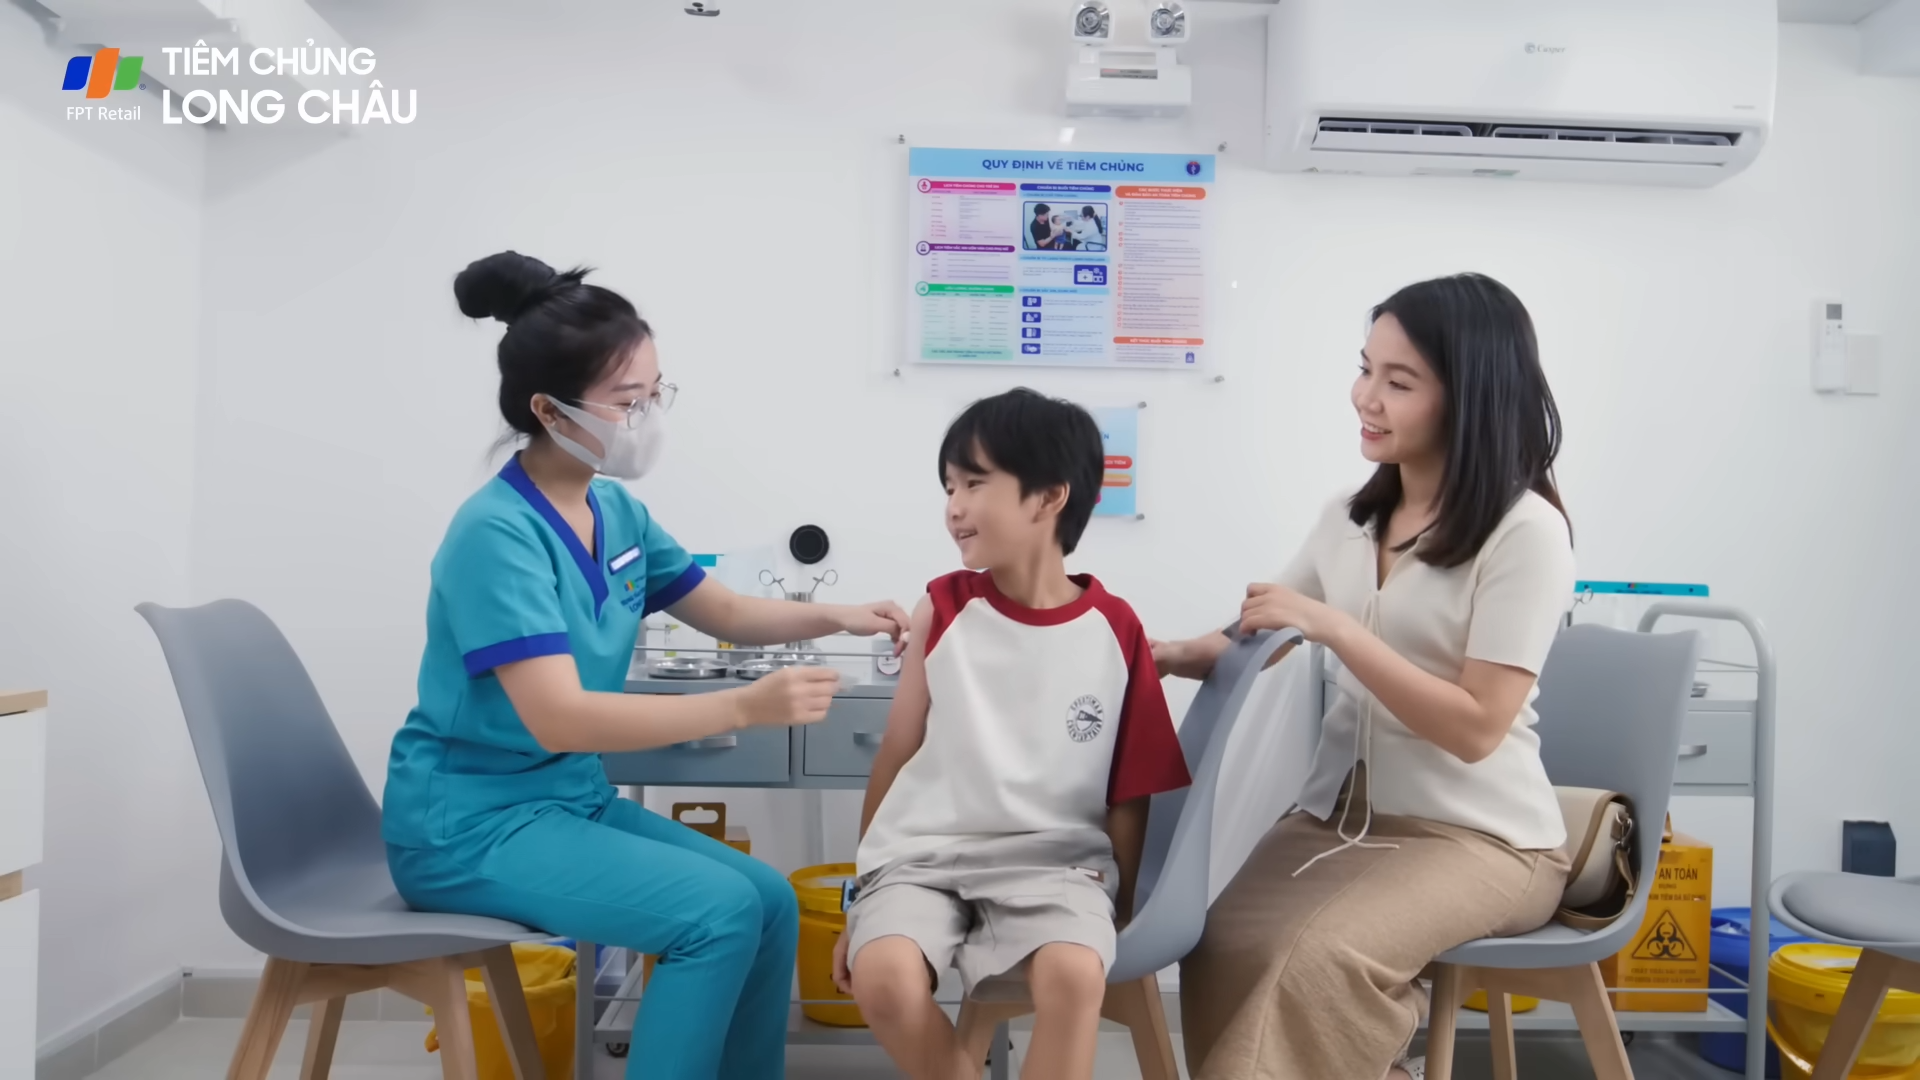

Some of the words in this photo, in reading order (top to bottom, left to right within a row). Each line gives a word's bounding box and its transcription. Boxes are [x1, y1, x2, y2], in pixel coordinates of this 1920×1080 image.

[982, 159, 1009, 171] QUY
[1011, 159, 1044, 172] ĐỊNH
[1066, 159, 1097, 171] TIÊM
[1099, 159, 1145, 173] CHỦNG
[1658, 867, 1672, 880] AN
